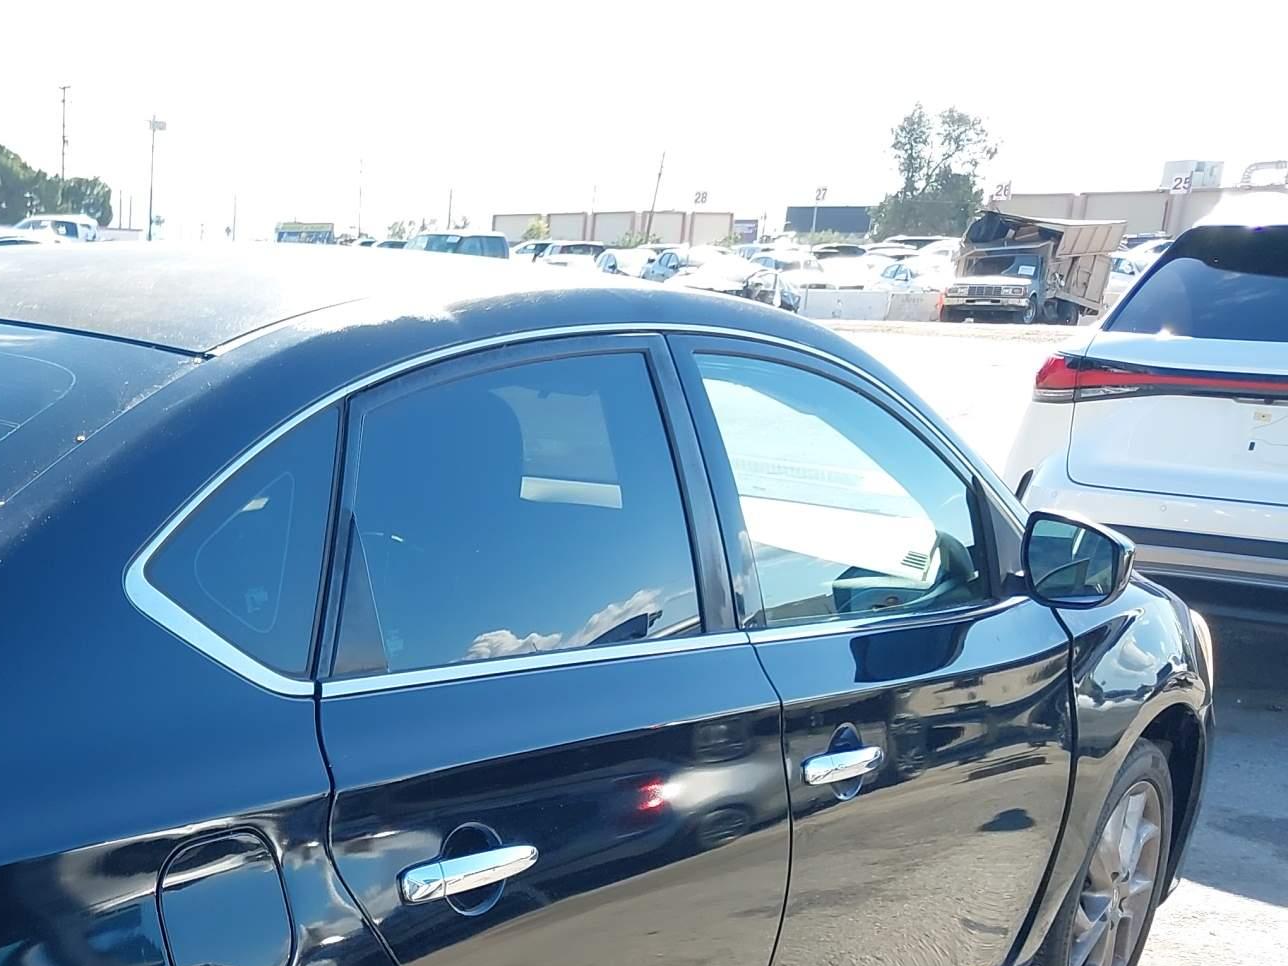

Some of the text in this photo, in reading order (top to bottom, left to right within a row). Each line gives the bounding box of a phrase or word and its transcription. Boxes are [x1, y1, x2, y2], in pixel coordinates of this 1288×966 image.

[1171, 176, 1193, 191] 25
[694, 191, 708, 204] 28
[815, 187, 828, 201] 27
